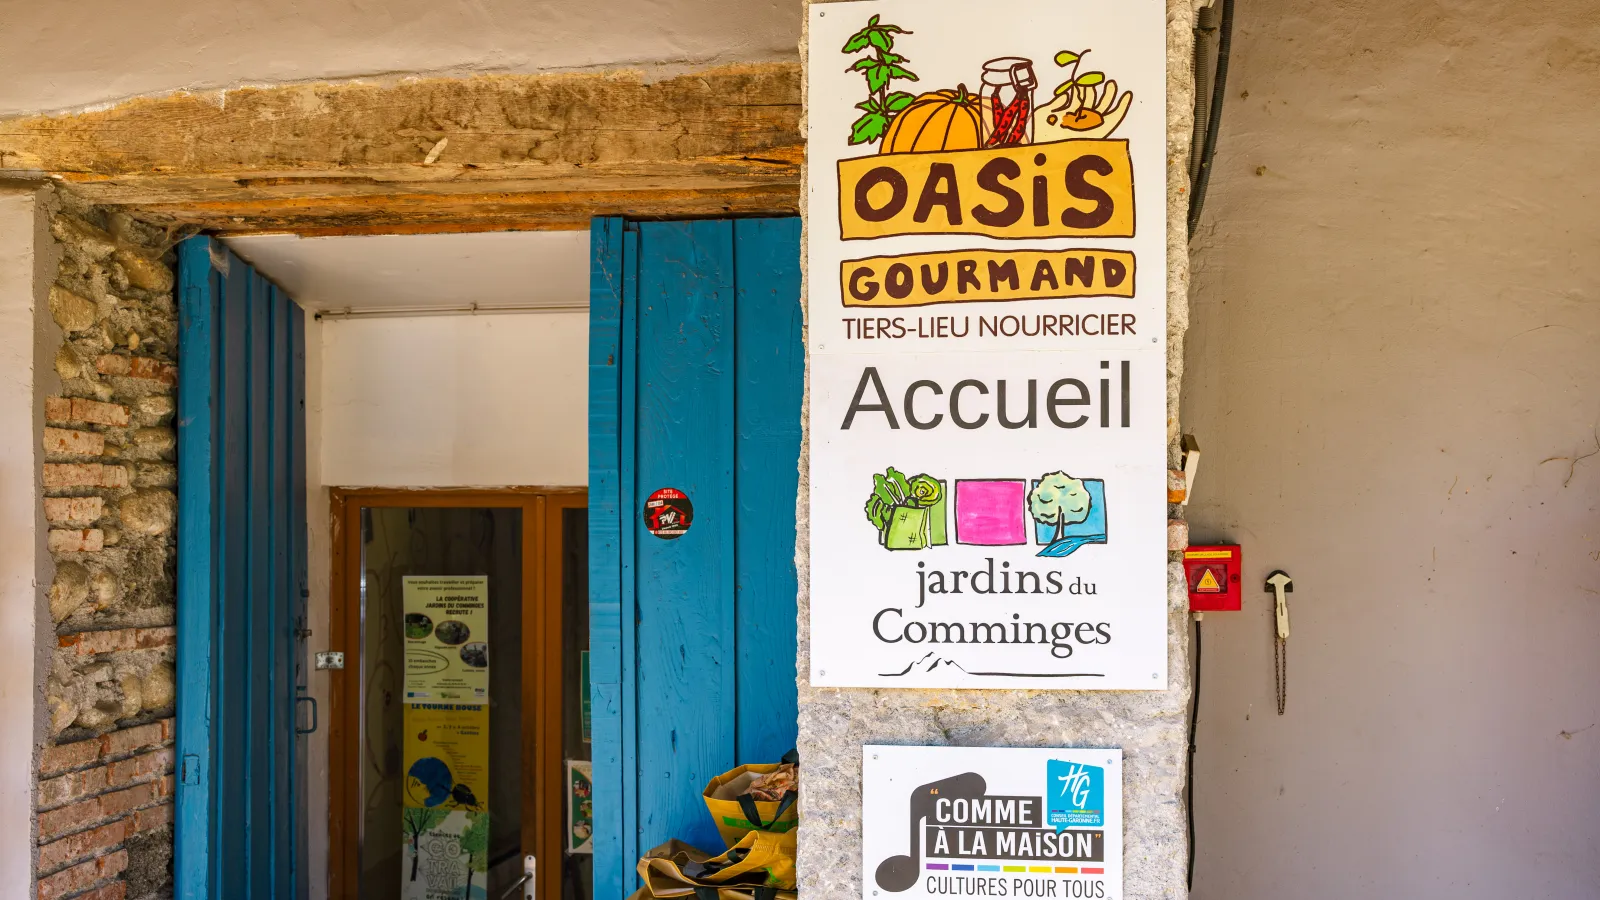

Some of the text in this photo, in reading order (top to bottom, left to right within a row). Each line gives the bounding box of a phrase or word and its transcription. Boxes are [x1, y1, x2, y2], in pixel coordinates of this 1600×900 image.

[849, 256, 1127, 301] GOURMAND
[842, 313, 1137, 340] TIERS-LIEU NOURRICIER
[840, 360, 1131, 430] Accueil
[915, 557, 1097, 608] jardins du
[872, 607, 1111, 659] Comminges
[934, 827, 950, 855] À
[958, 830, 988, 856] LA
[926, 875, 1105, 898] CULTURES POUR TOUS
